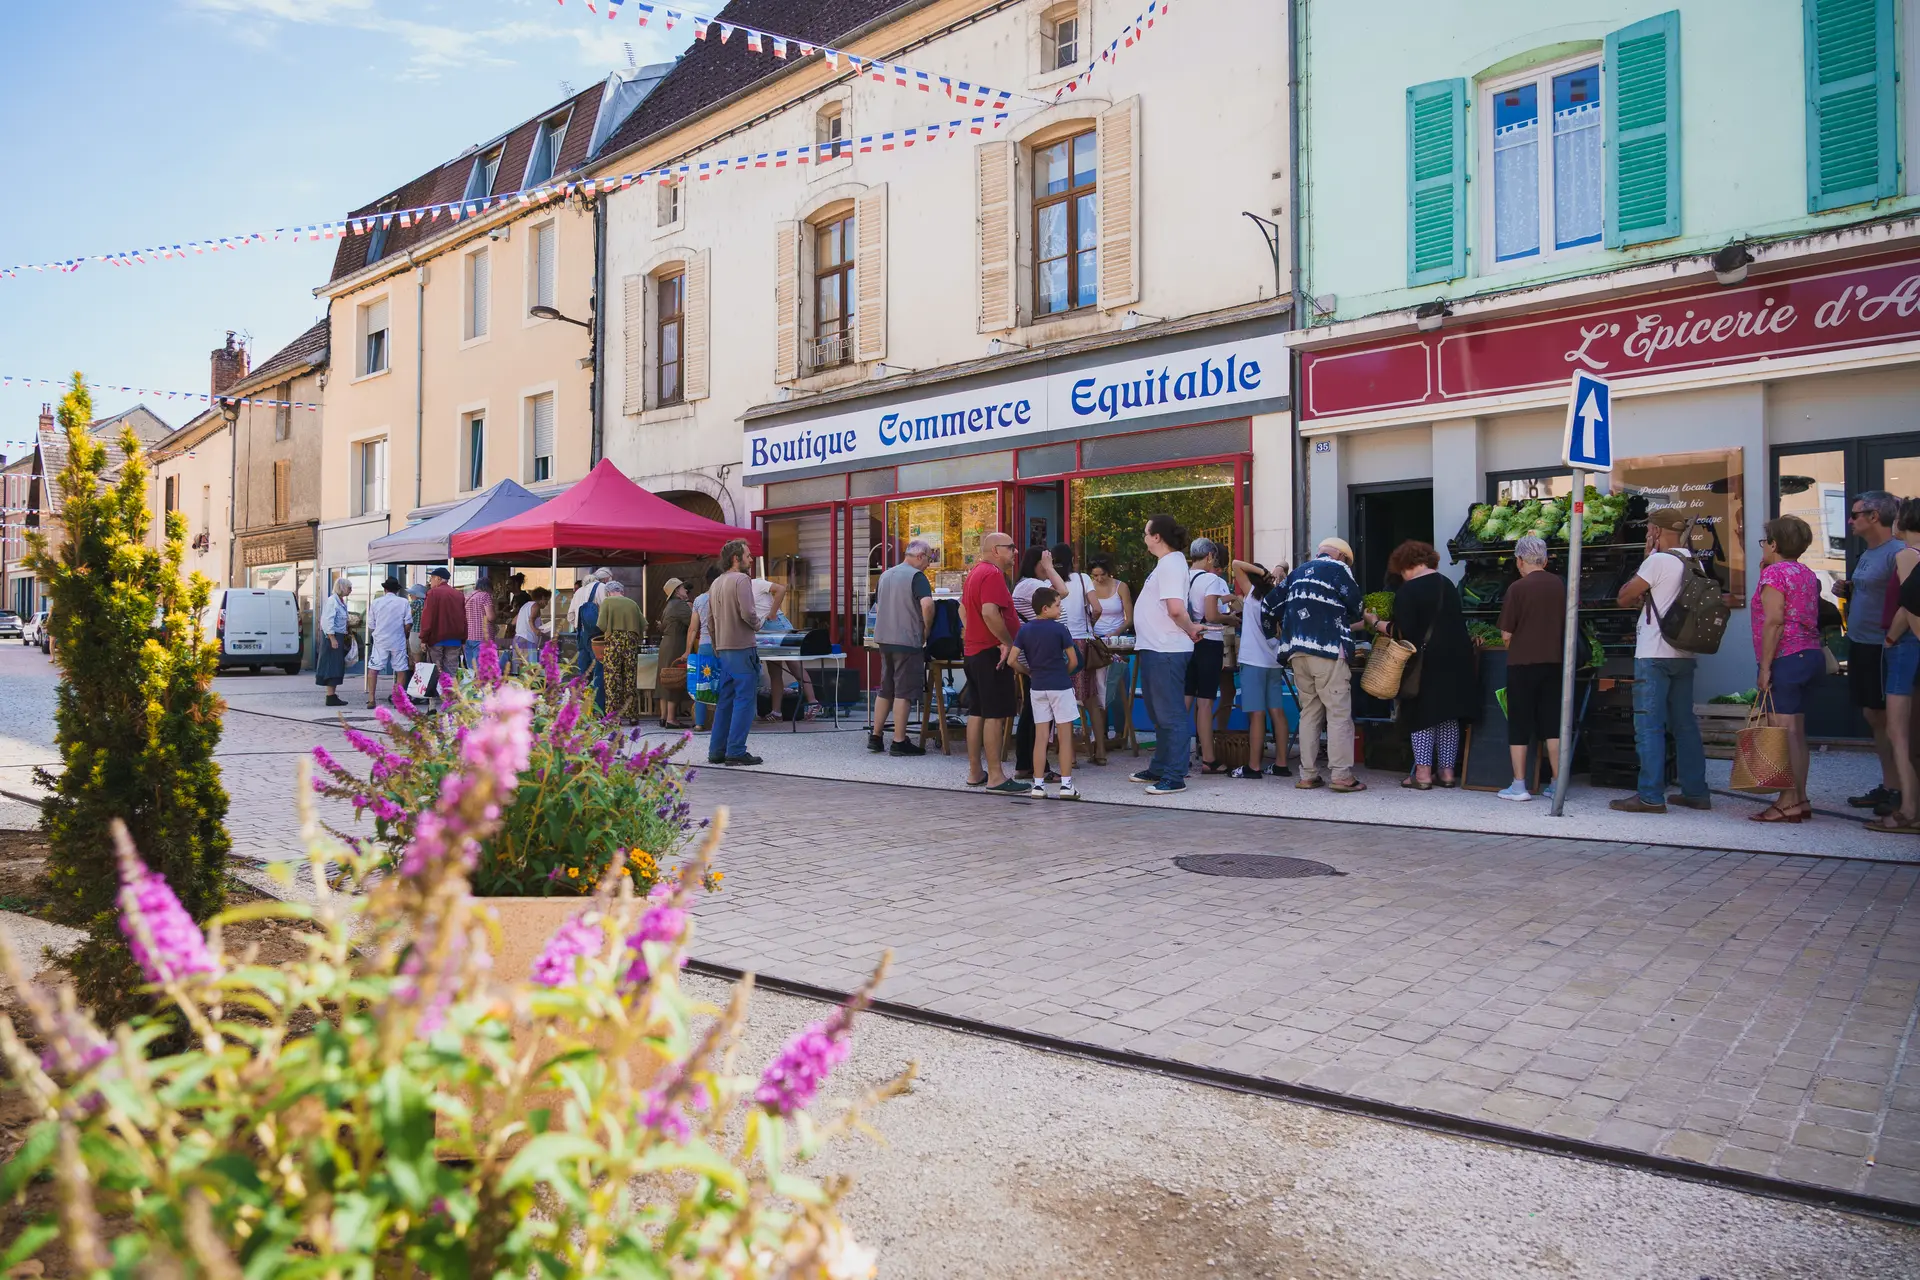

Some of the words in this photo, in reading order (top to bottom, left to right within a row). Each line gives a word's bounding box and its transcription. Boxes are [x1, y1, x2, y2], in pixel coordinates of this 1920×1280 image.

[1564, 297, 1798, 370] L'Epicerie
[1814, 274, 1920, 329] d'A
[751, 430, 857, 467] Boutique
[878, 399, 1031, 446] Commerce
[1071, 354, 1262, 420] Equitable
[1638, 484, 1679, 495] Produits
[1681, 483, 1714, 492] locaux
[1645, 500, 1688, 513] Produits
[1690, 498, 1704, 508] bio
[1696, 516, 1722, 525] coupe
